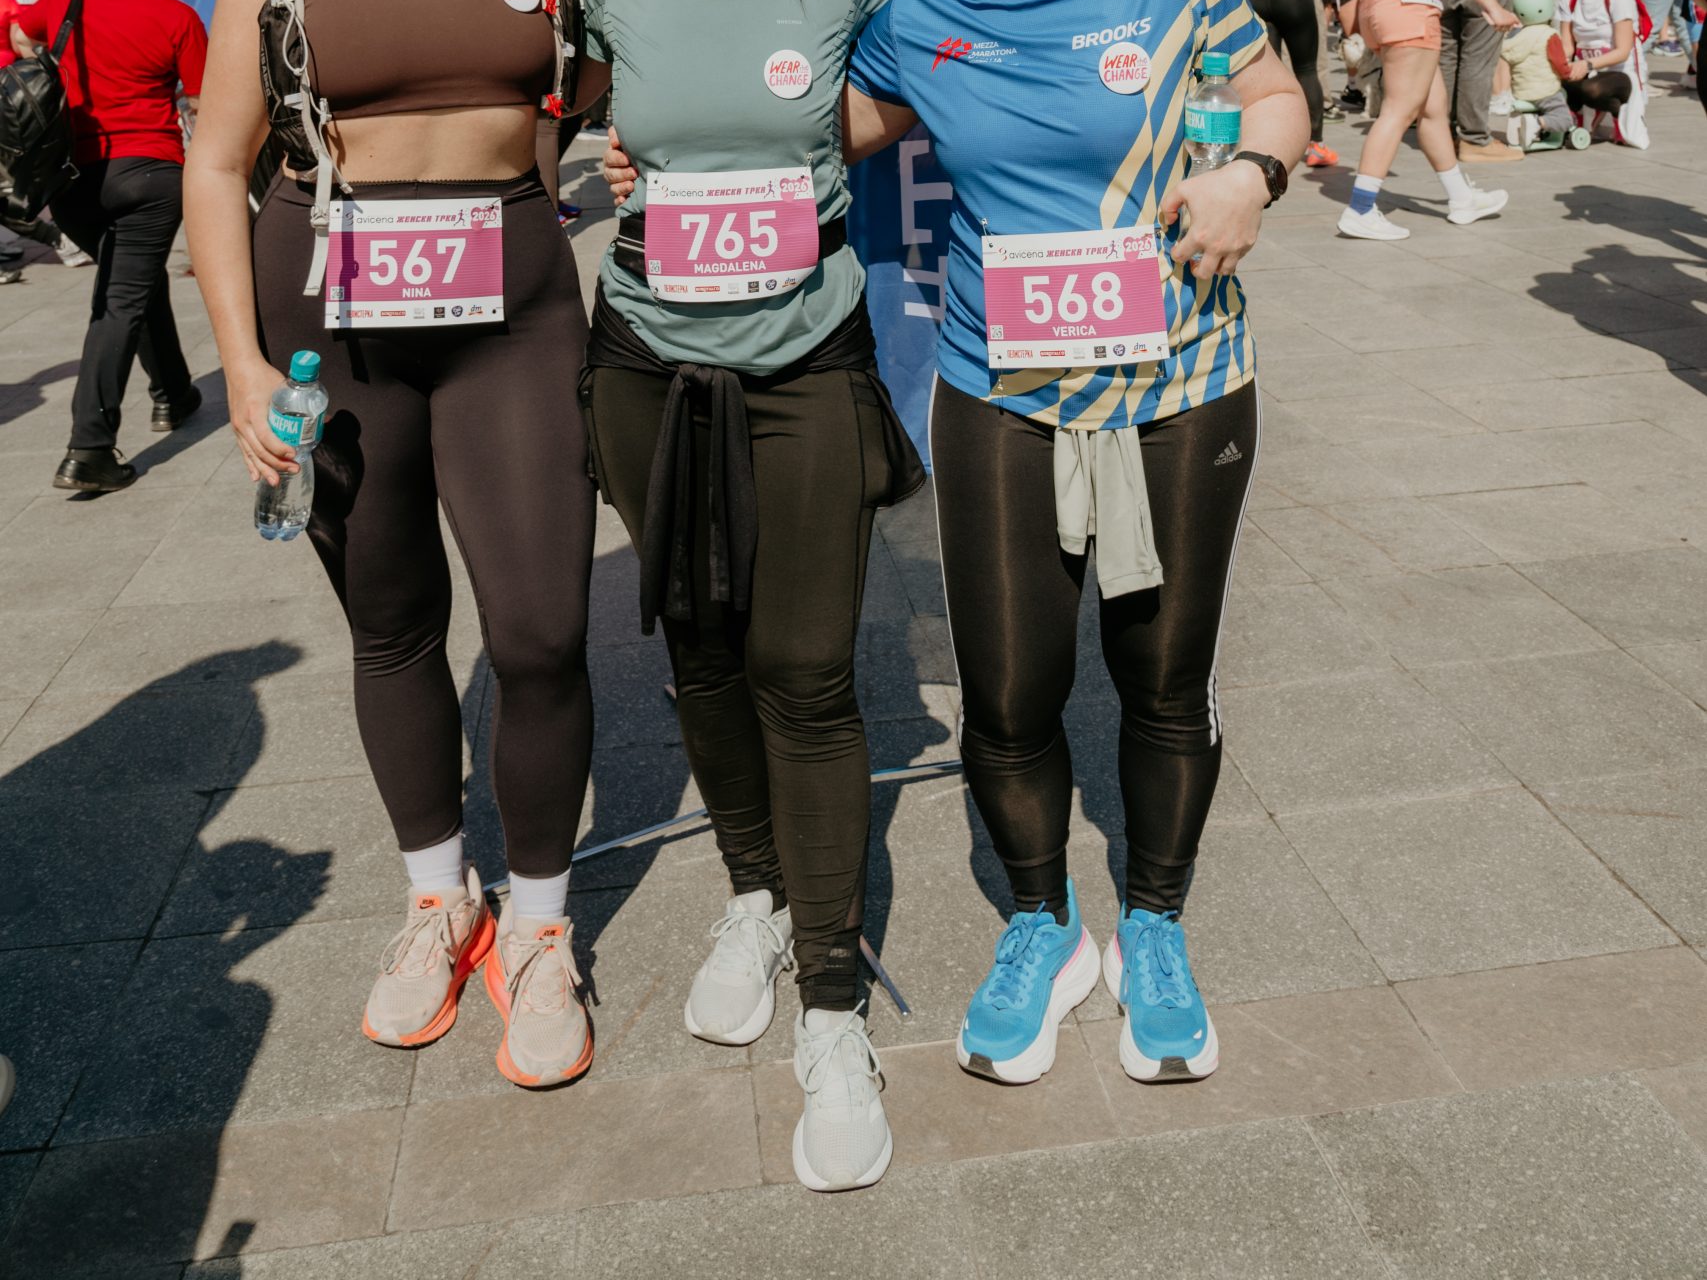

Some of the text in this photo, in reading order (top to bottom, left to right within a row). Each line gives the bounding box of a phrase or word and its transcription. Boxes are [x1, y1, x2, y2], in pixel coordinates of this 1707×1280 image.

[1071, 16, 1152, 50] BROOKS
[973, 41, 999, 49] MEZZA
[971, 48, 1018, 57] MARATONA
[769, 60, 801, 74] WEAR
[1104, 53, 1138, 69] WEAR
[769, 74, 809, 87] CHANGE
[1103, 67, 1148, 83] CHANGE
[670, 187, 704, 197] avicena
[782, 182, 807, 193] 2026
[356, 216, 394, 224] avicena
[472, 210, 495, 222] 2026
[680, 209, 779, 261] 765
[1124, 240, 1151, 252] 2026
[1008, 249, 1044, 260] avicena
[368, 237, 467, 286] 567
[694, 260, 767, 274] MAGDALENA
[402, 287, 432, 298] NINA
[1022, 271, 1124, 325] 568
[470, 304, 483, 312] dm
[1052, 325, 1097, 337] VERICA
[1133, 342, 1146, 350] dm
[1214, 452, 1243, 466] adidas
